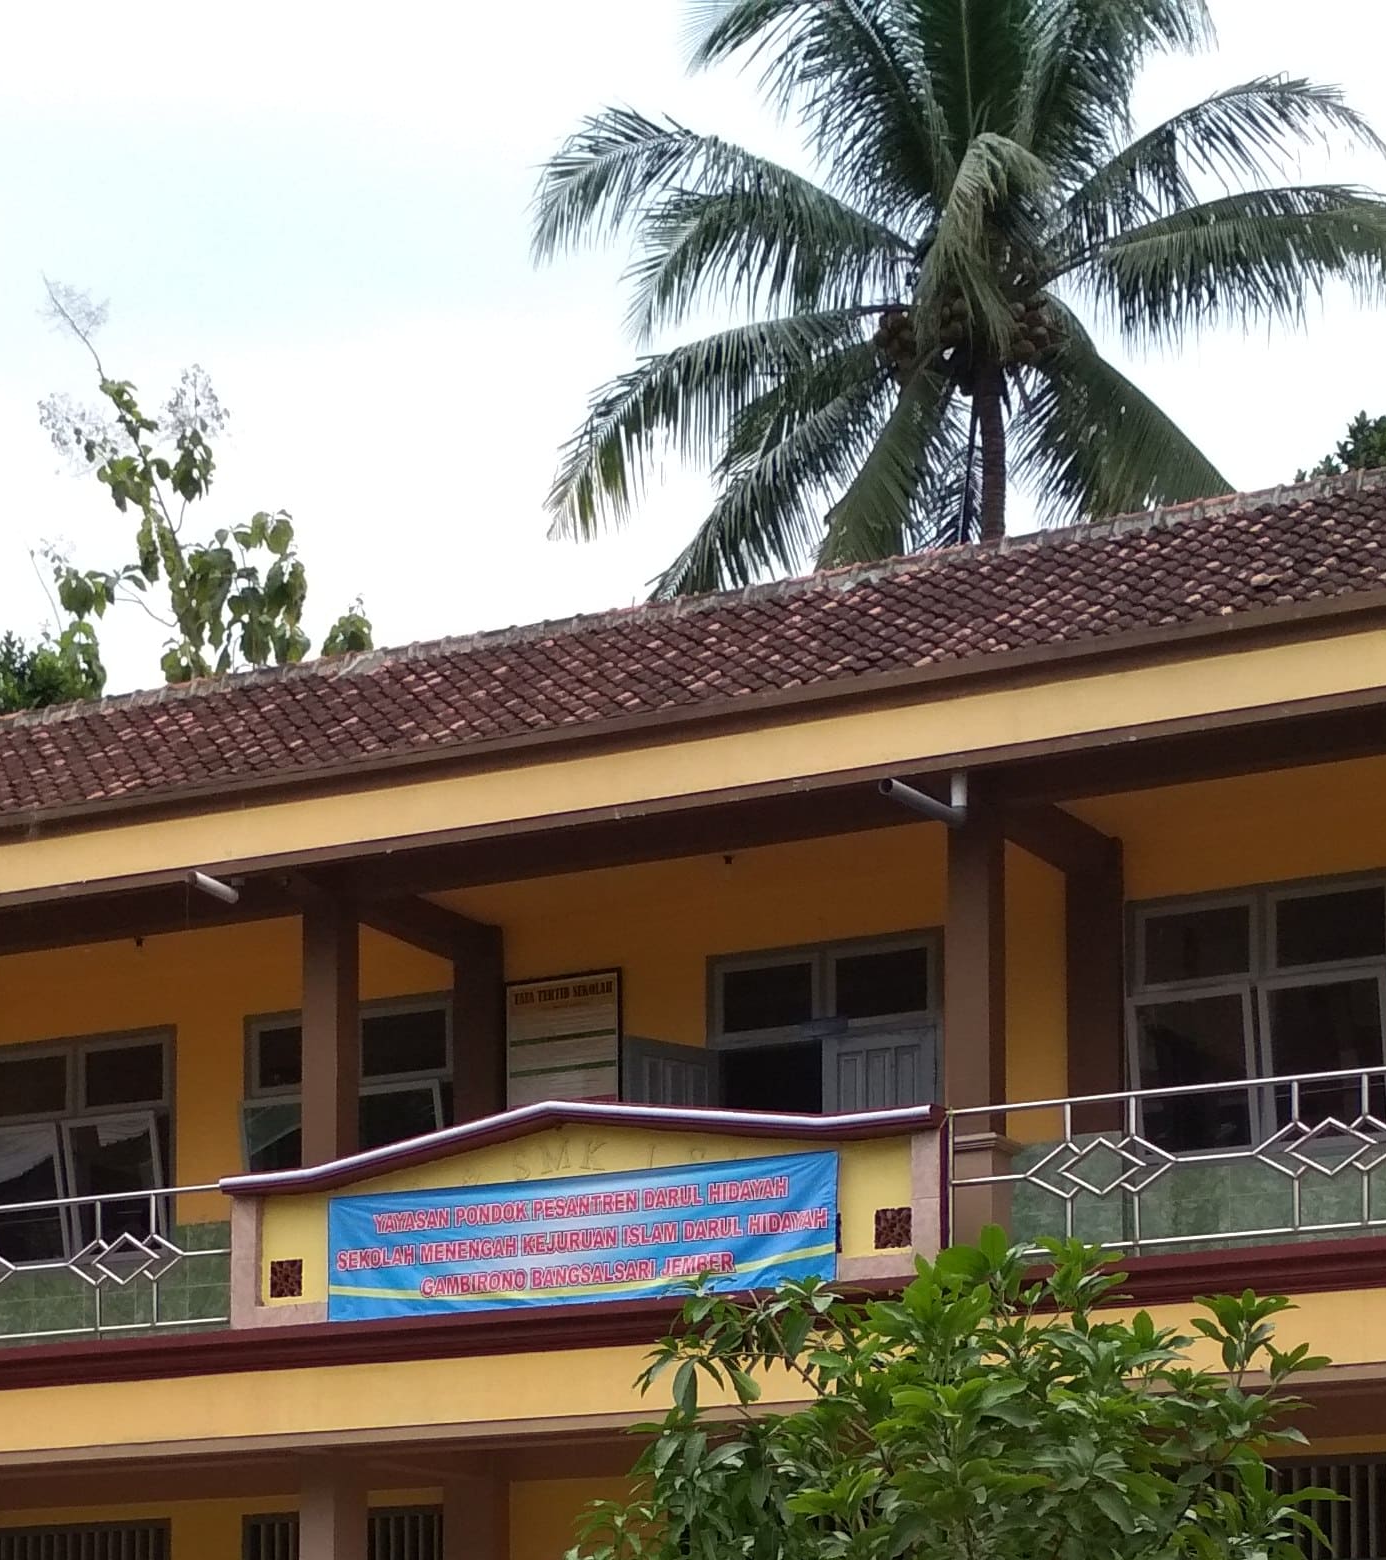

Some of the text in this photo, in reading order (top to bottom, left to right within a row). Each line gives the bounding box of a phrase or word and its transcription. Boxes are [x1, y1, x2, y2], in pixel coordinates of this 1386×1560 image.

[572, 981, 613, 998] SEKOLAH
[373, 1176, 788, 1233] YAYASAN PONDOK PESANTREN DARUL HIDAYAH
[337, 1207, 828, 1271] SEKOLAH MENENGAH KEJURUAN ISLAM DARUL HIDAYAH
[420, 1251, 735, 1298] GAMBIRONO BANGSALSARI JEMBER
